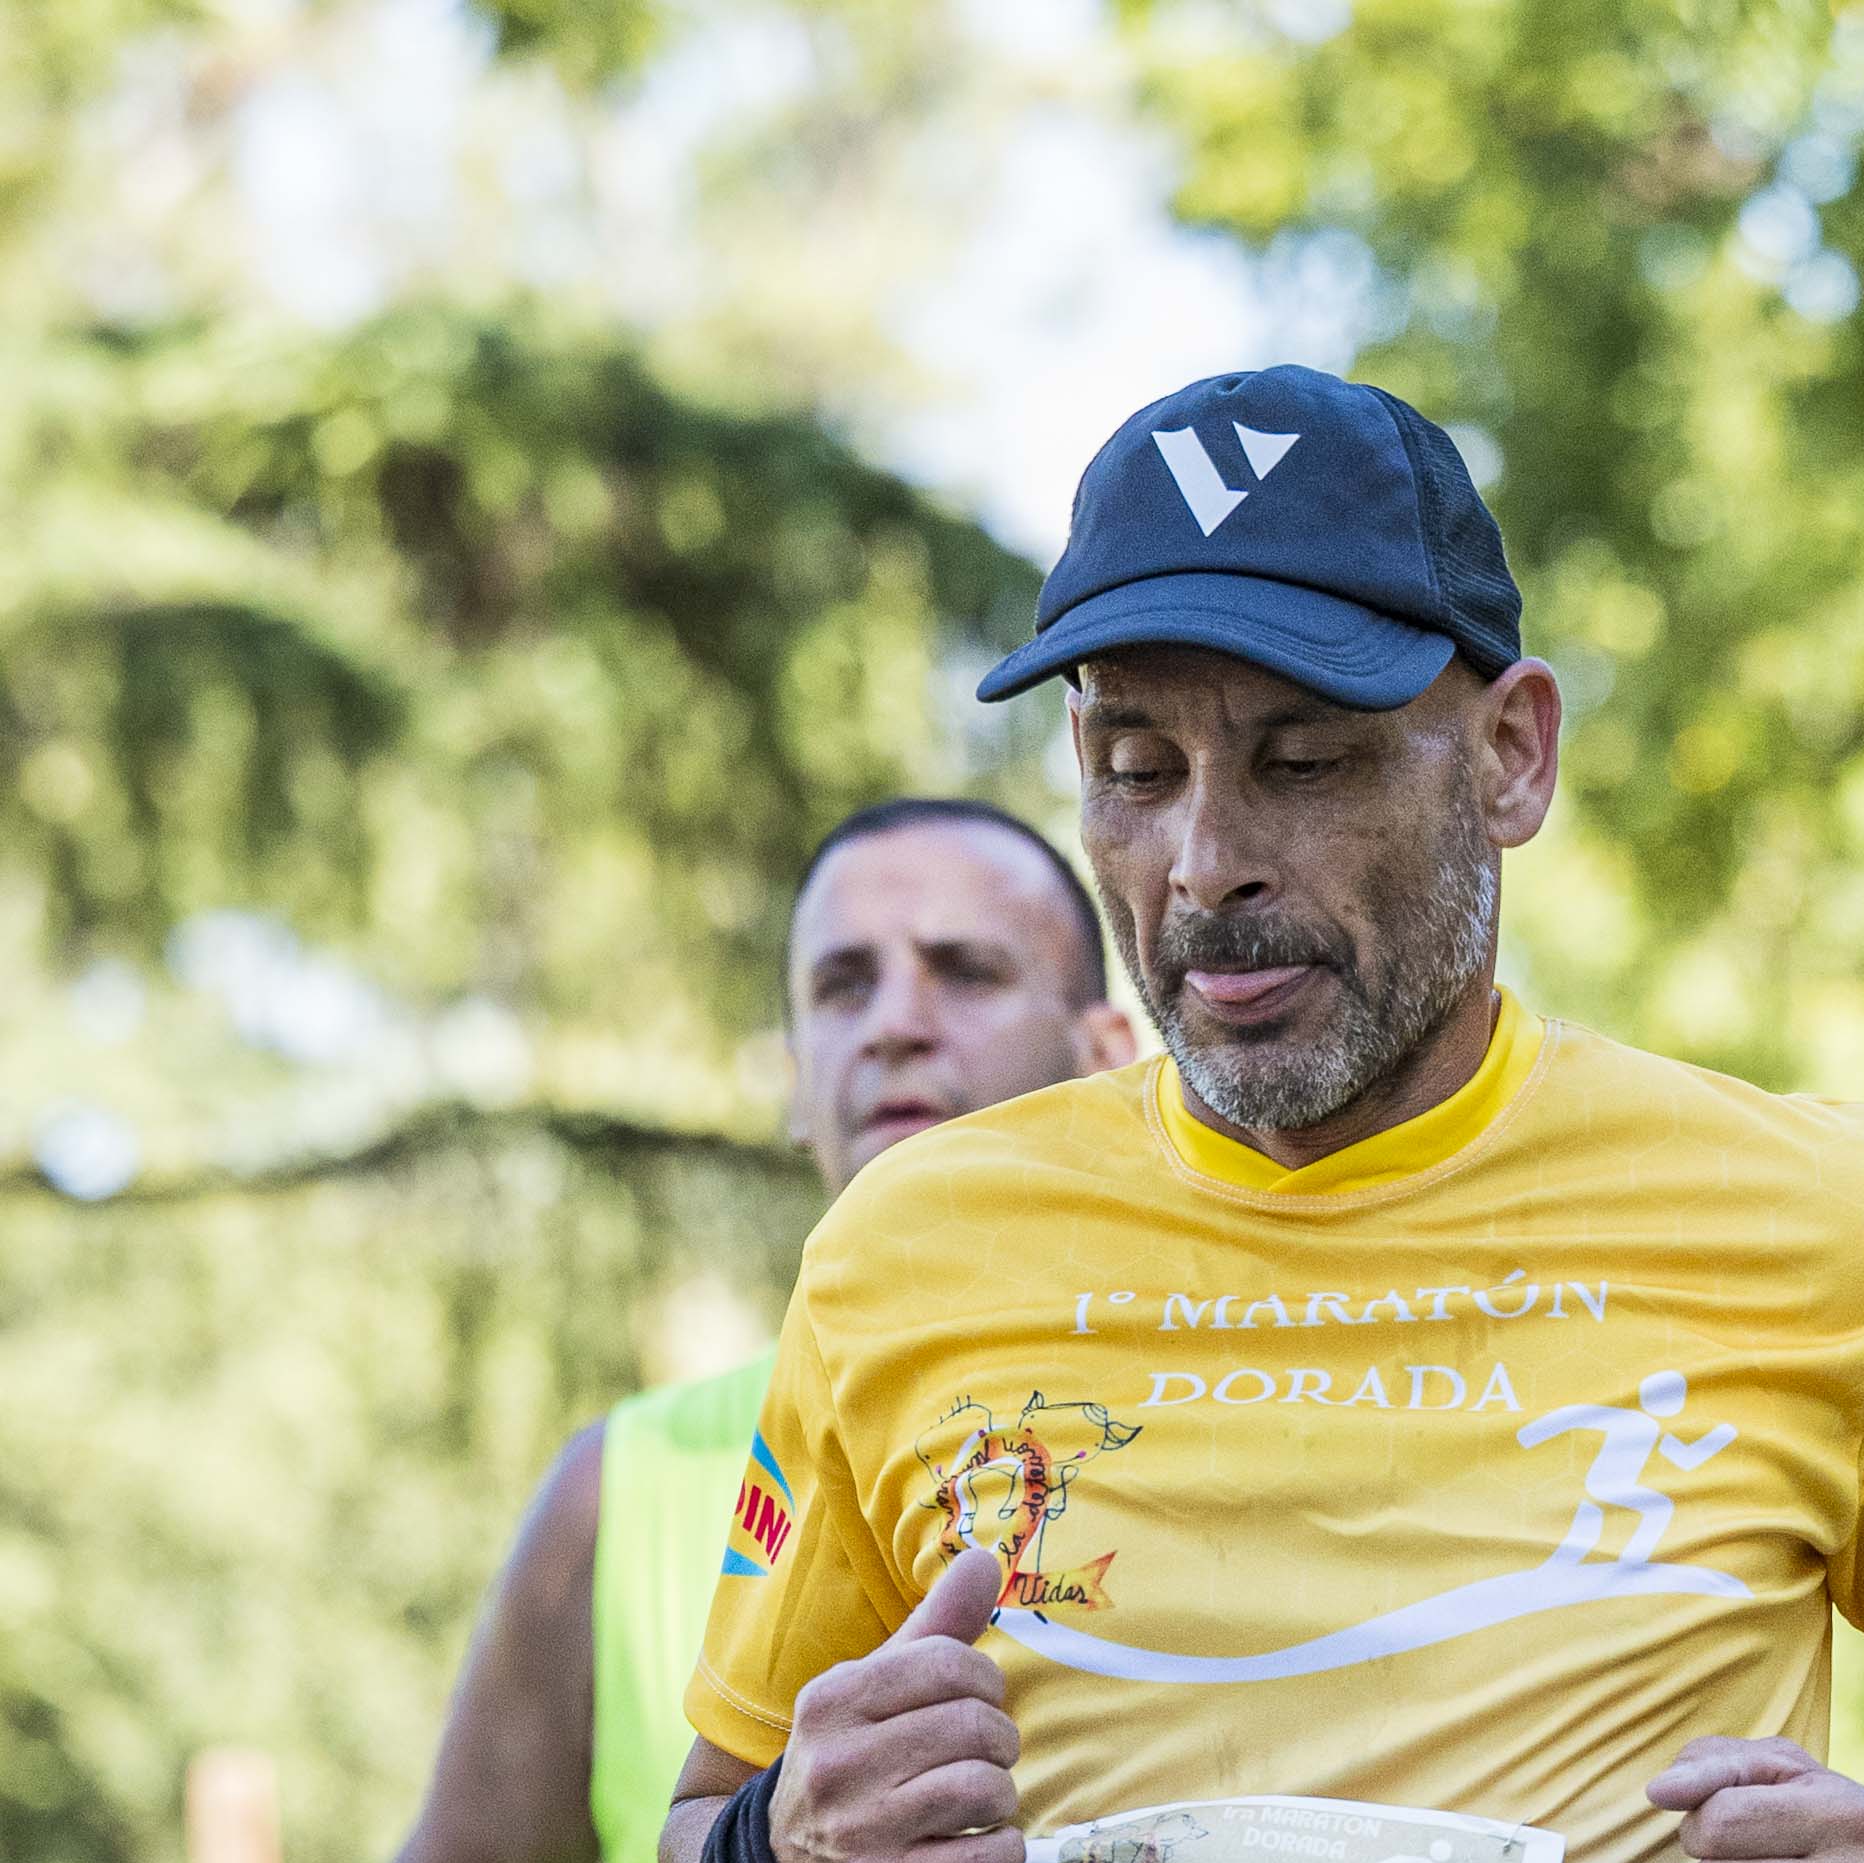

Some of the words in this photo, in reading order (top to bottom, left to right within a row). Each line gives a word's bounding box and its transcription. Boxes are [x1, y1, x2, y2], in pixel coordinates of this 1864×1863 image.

[1157, 1269, 1609, 1332] MARATÓN
[1138, 1362, 1523, 1412] DORADA
[1013, 1573, 1089, 1606] Vidas
[1242, 1825, 1348, 1860] DORADA
